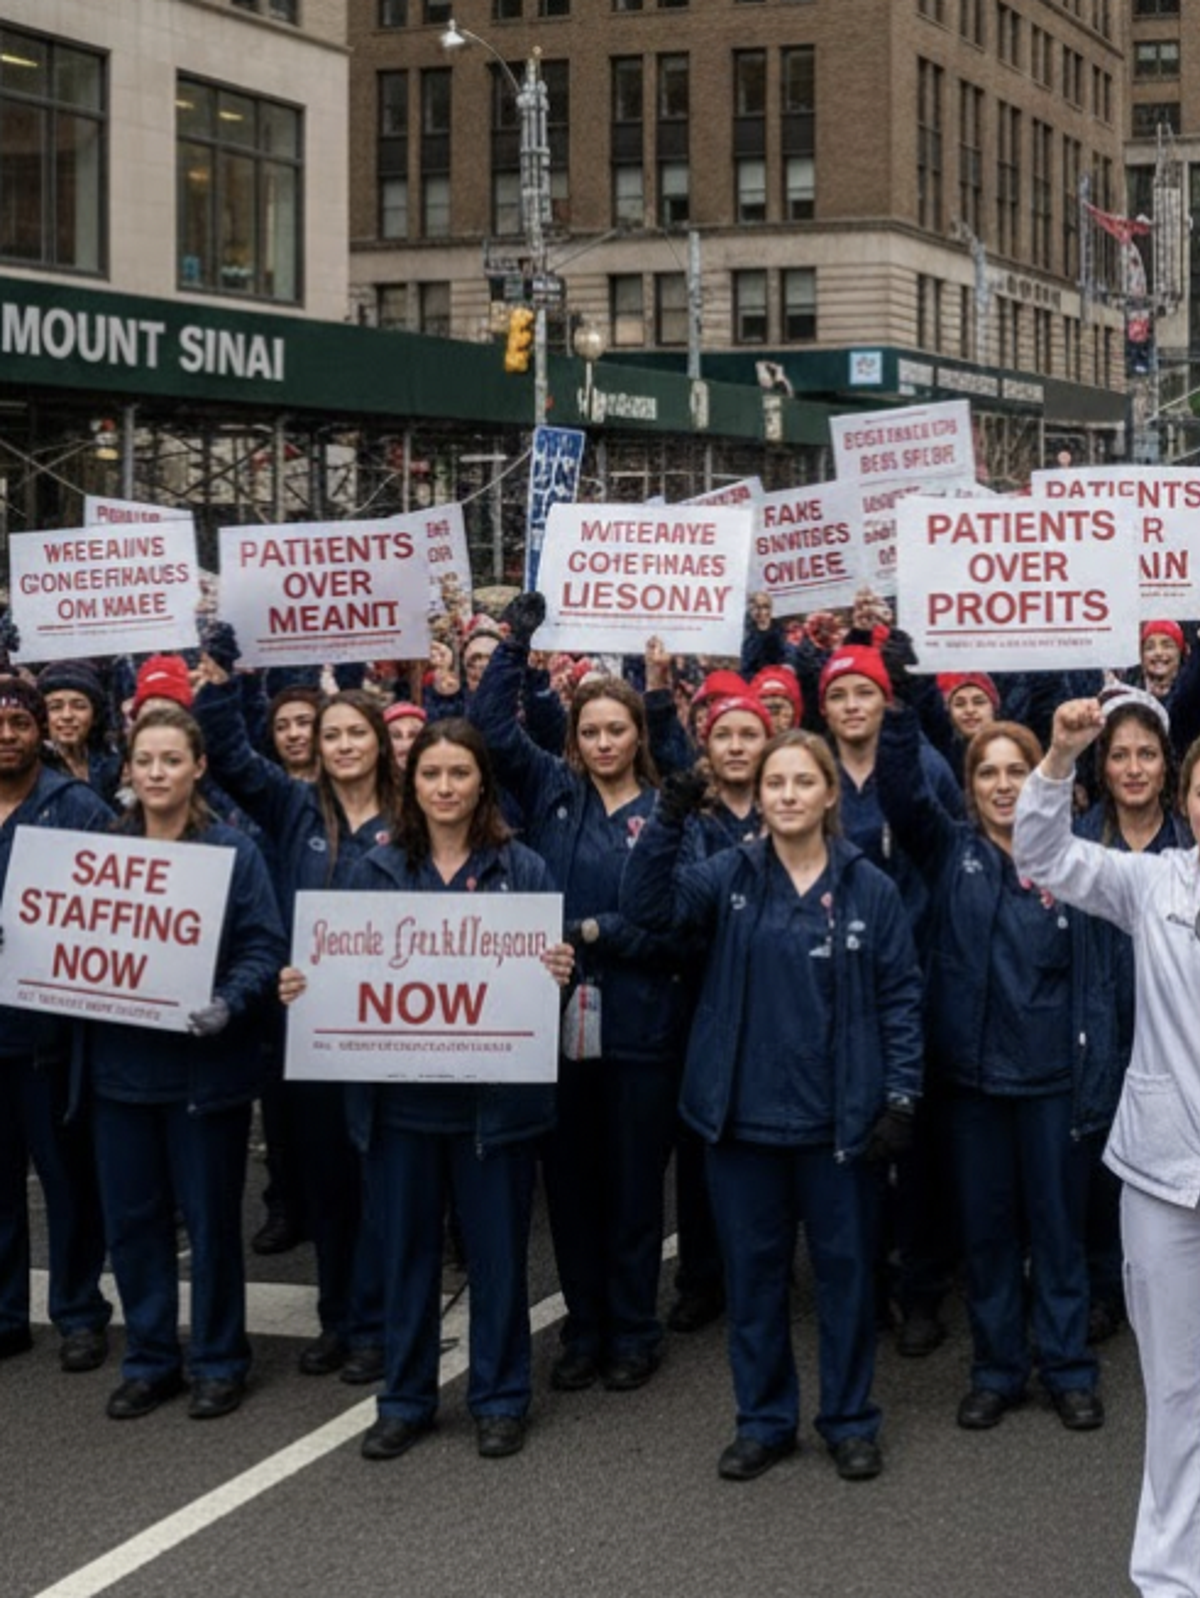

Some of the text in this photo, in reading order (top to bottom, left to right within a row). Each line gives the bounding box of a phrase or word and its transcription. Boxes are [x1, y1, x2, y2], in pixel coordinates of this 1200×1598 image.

[2, 303, 285, 381] MOUNT SINAI
[927, 509, 1116, 544] PATIENTS
[283, 570, 372, 599] OVER
[969, 551, 1068, 583] OVER
[928, 590, 1109, 625] PROFITS
[72, 850, 171, 894] SAFE
[19, 888, 201, 945] STAFFING
[52, 942, 147, 990] NOW
[359, 982, 487, 1025] NOW
